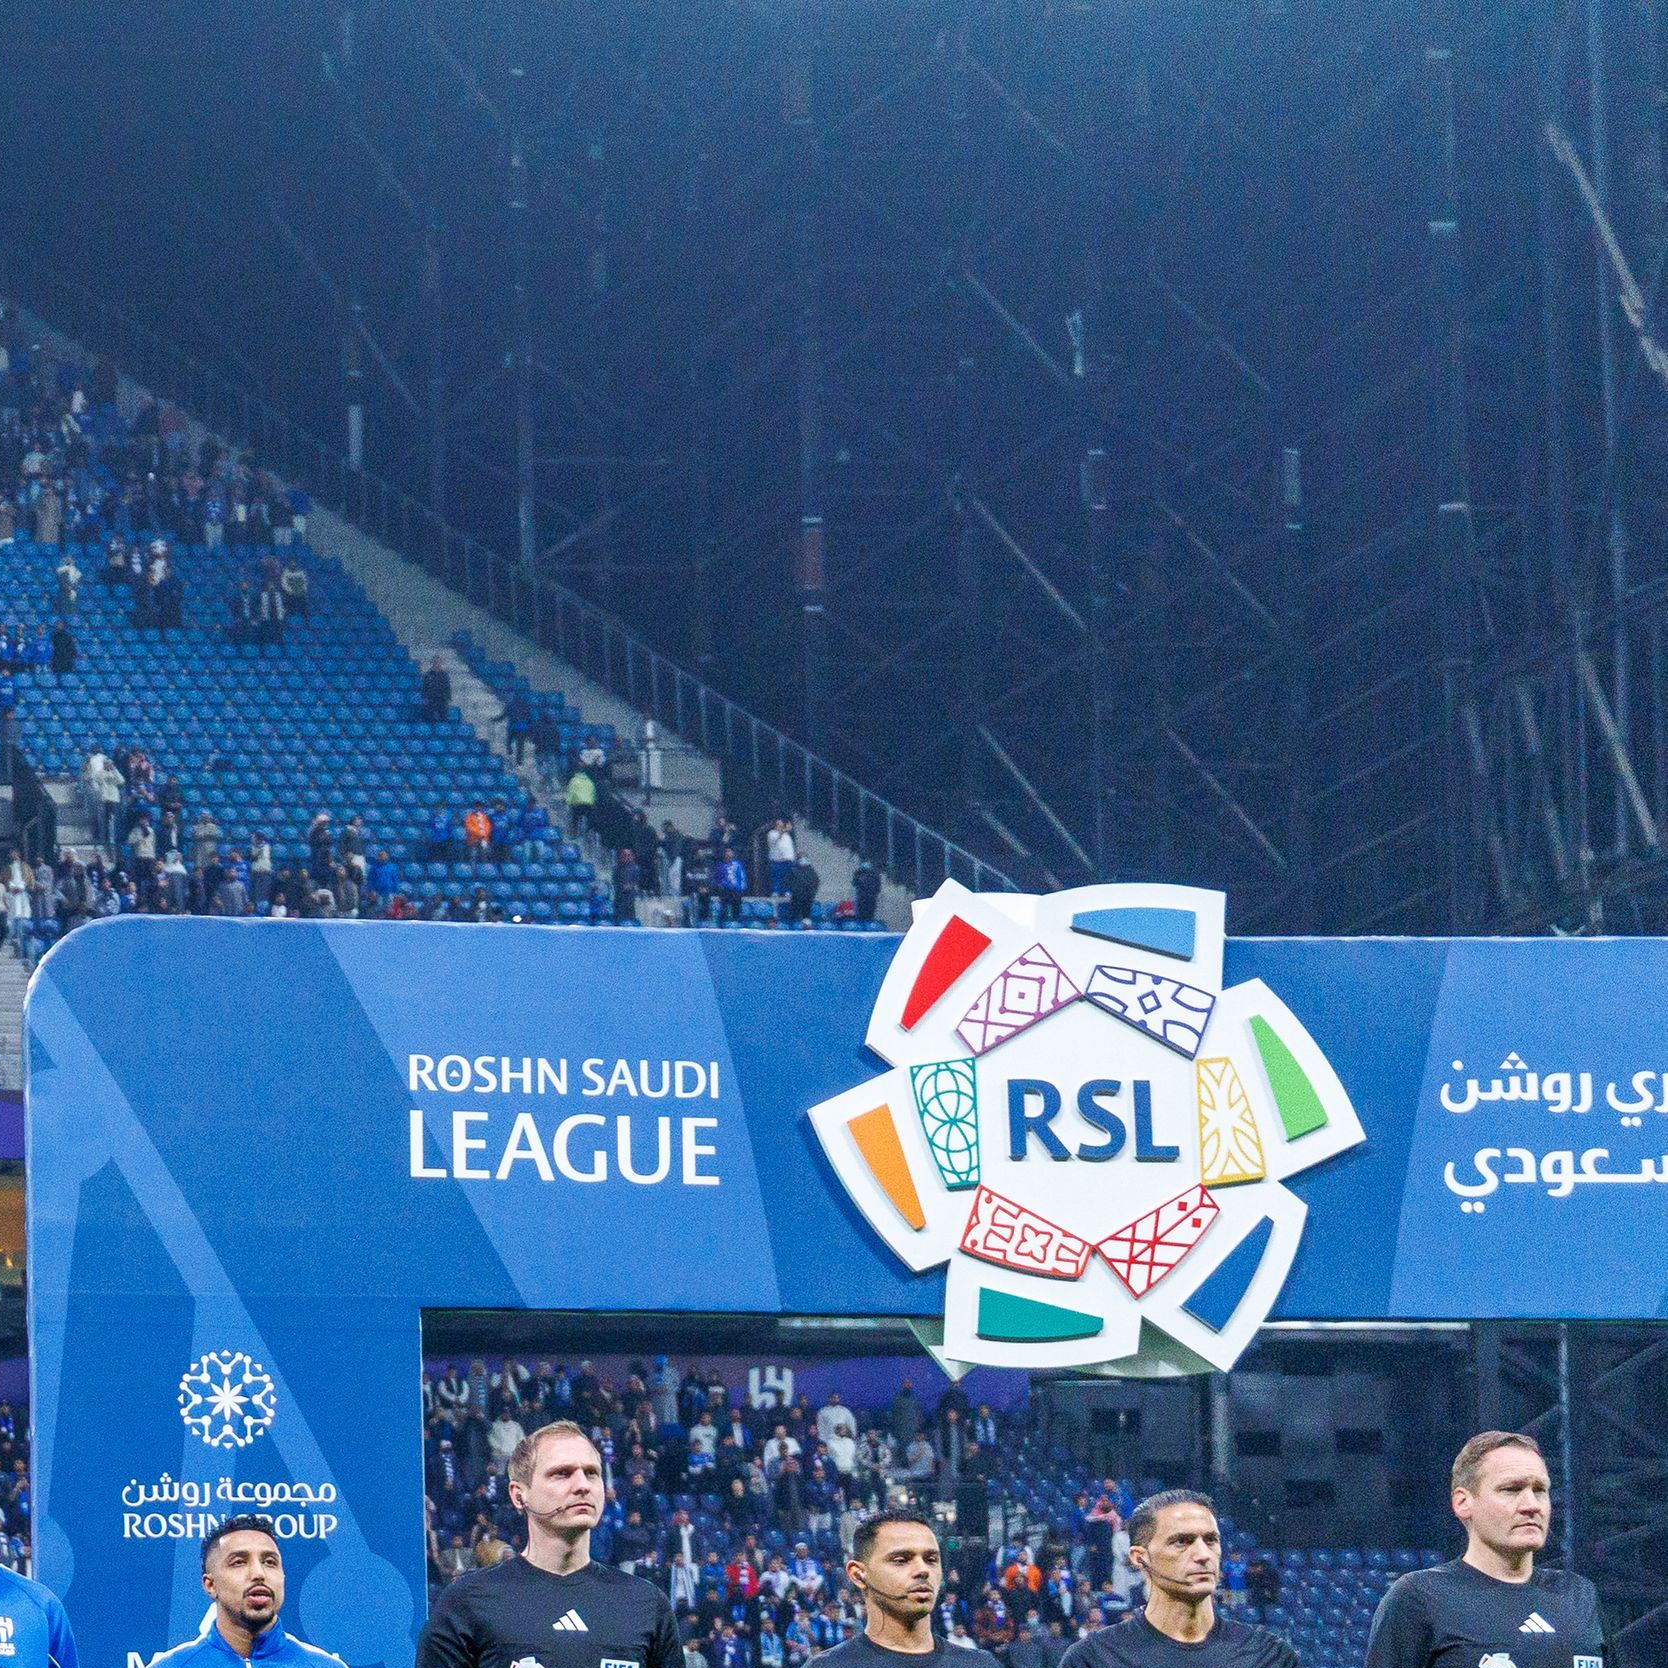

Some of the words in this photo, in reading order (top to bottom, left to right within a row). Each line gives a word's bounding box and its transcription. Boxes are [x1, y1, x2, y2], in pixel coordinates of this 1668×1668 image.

[408, 1054, 568, 1095] ROSHN
[581, 1058, 720, 1099] SAUDI
[1439, 1051, 1594, 1114] روشن
[1007, 1078, 1181, 1162] RSL
[409, 1109, 721, 1186] LEAGUE
[121, 1471, 212, 1508] روشن
[216, 1476, 337, 1508] مجموعة
[254, 1513, 339, 1539] OUP
